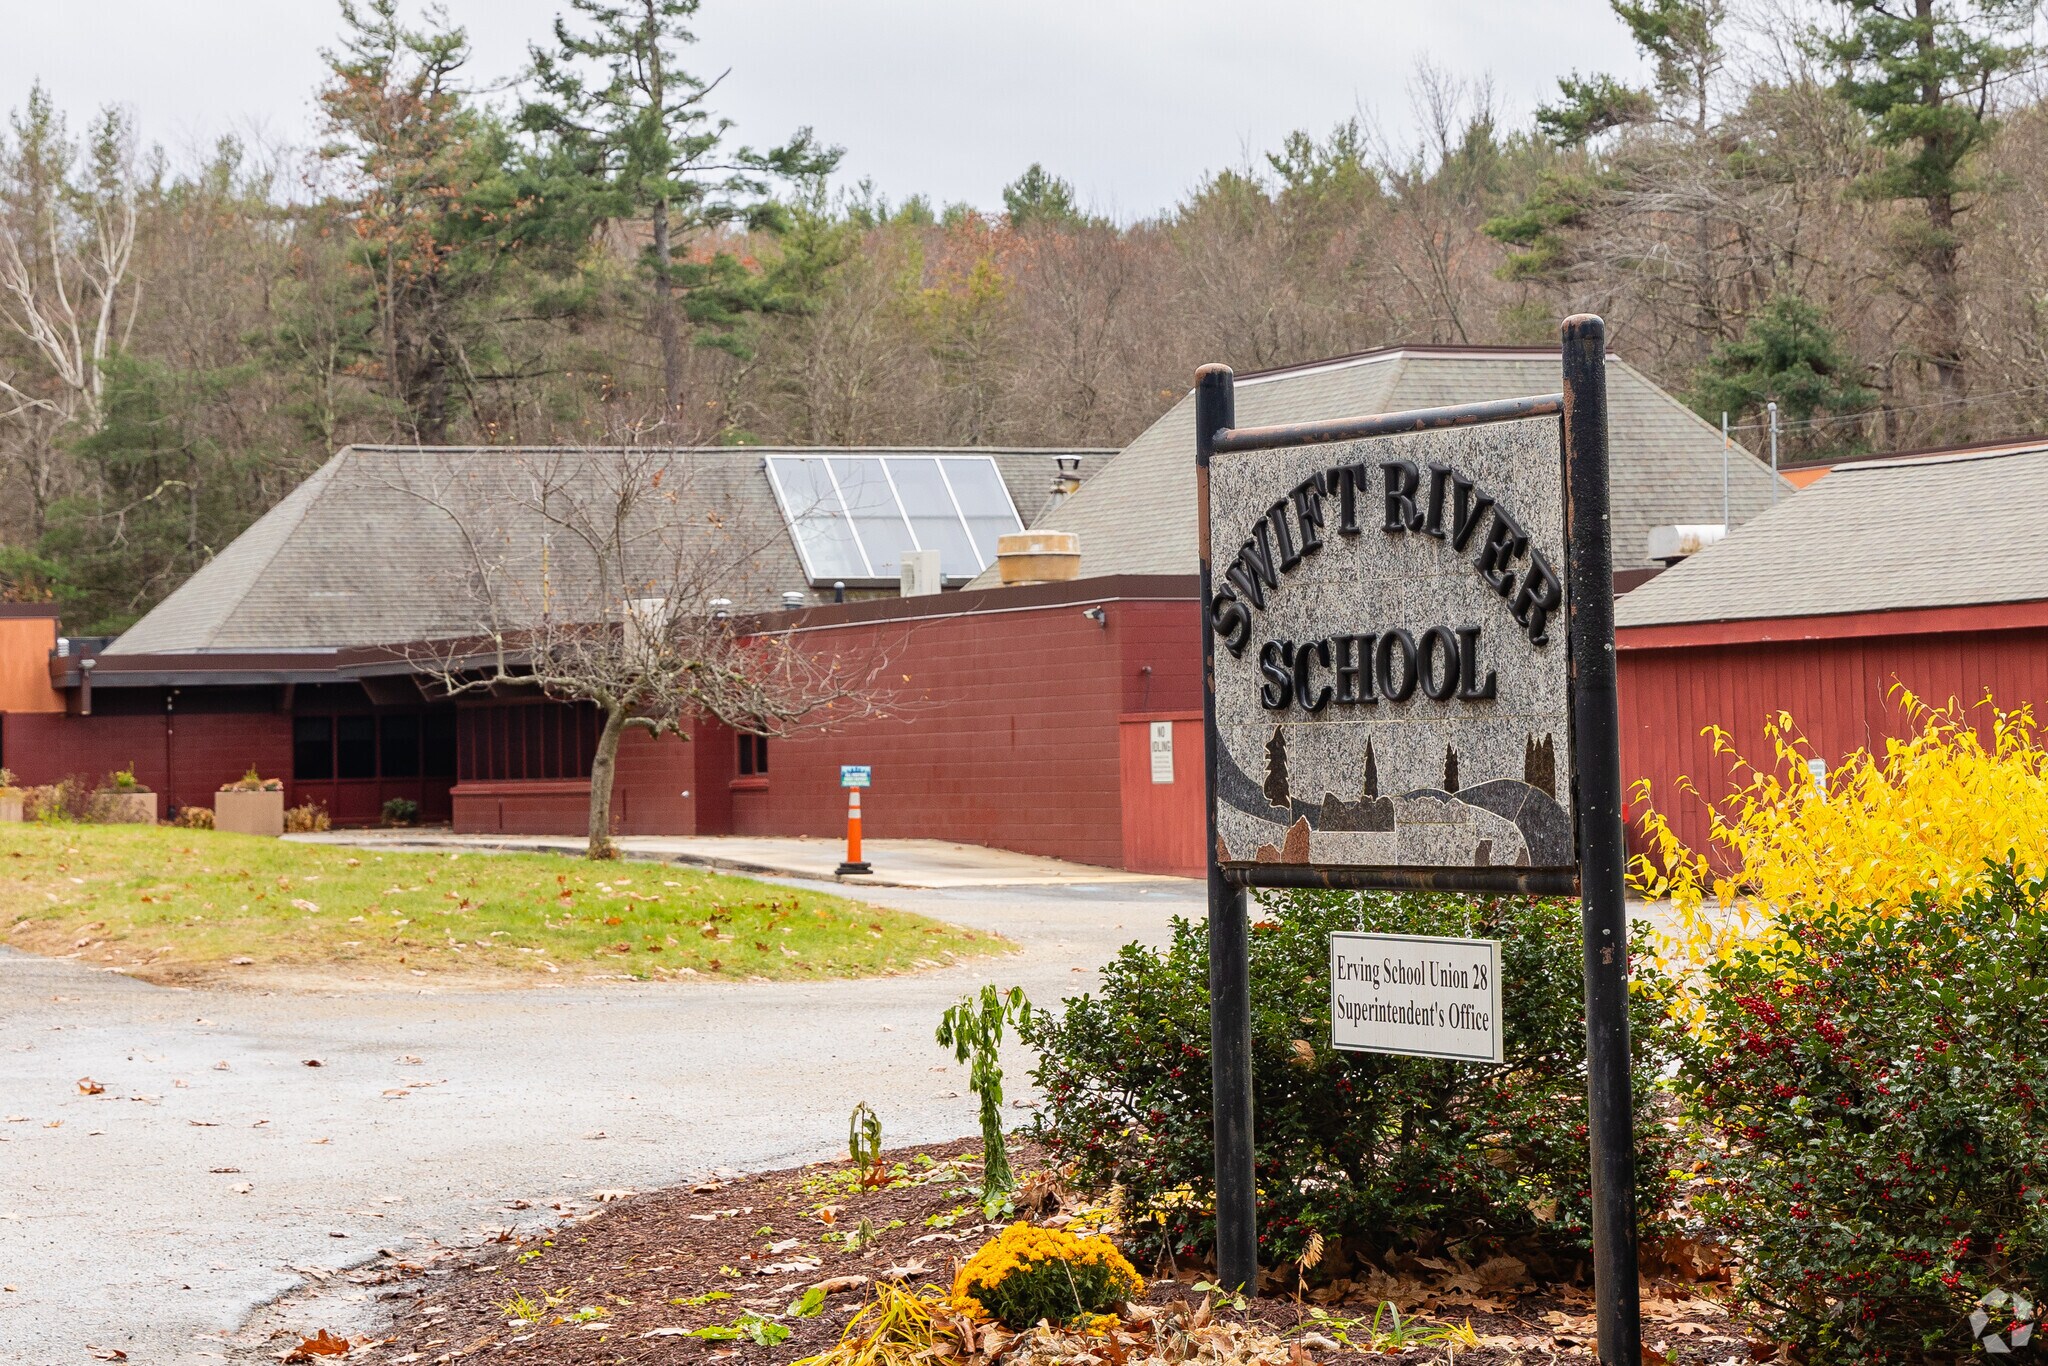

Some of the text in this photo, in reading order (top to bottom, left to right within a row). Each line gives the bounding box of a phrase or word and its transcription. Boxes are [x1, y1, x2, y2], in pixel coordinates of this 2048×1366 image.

[1210, 459, 1562, 659] SWIFT RIVER
[1259, 625, 1497, 713] SCHOOL
[1157, 726, 1165, 738] NO
[1337, 955, 1488, 990] Erving School Union 28
[1337, 994, 1489, 1031] Superintendent's Office
